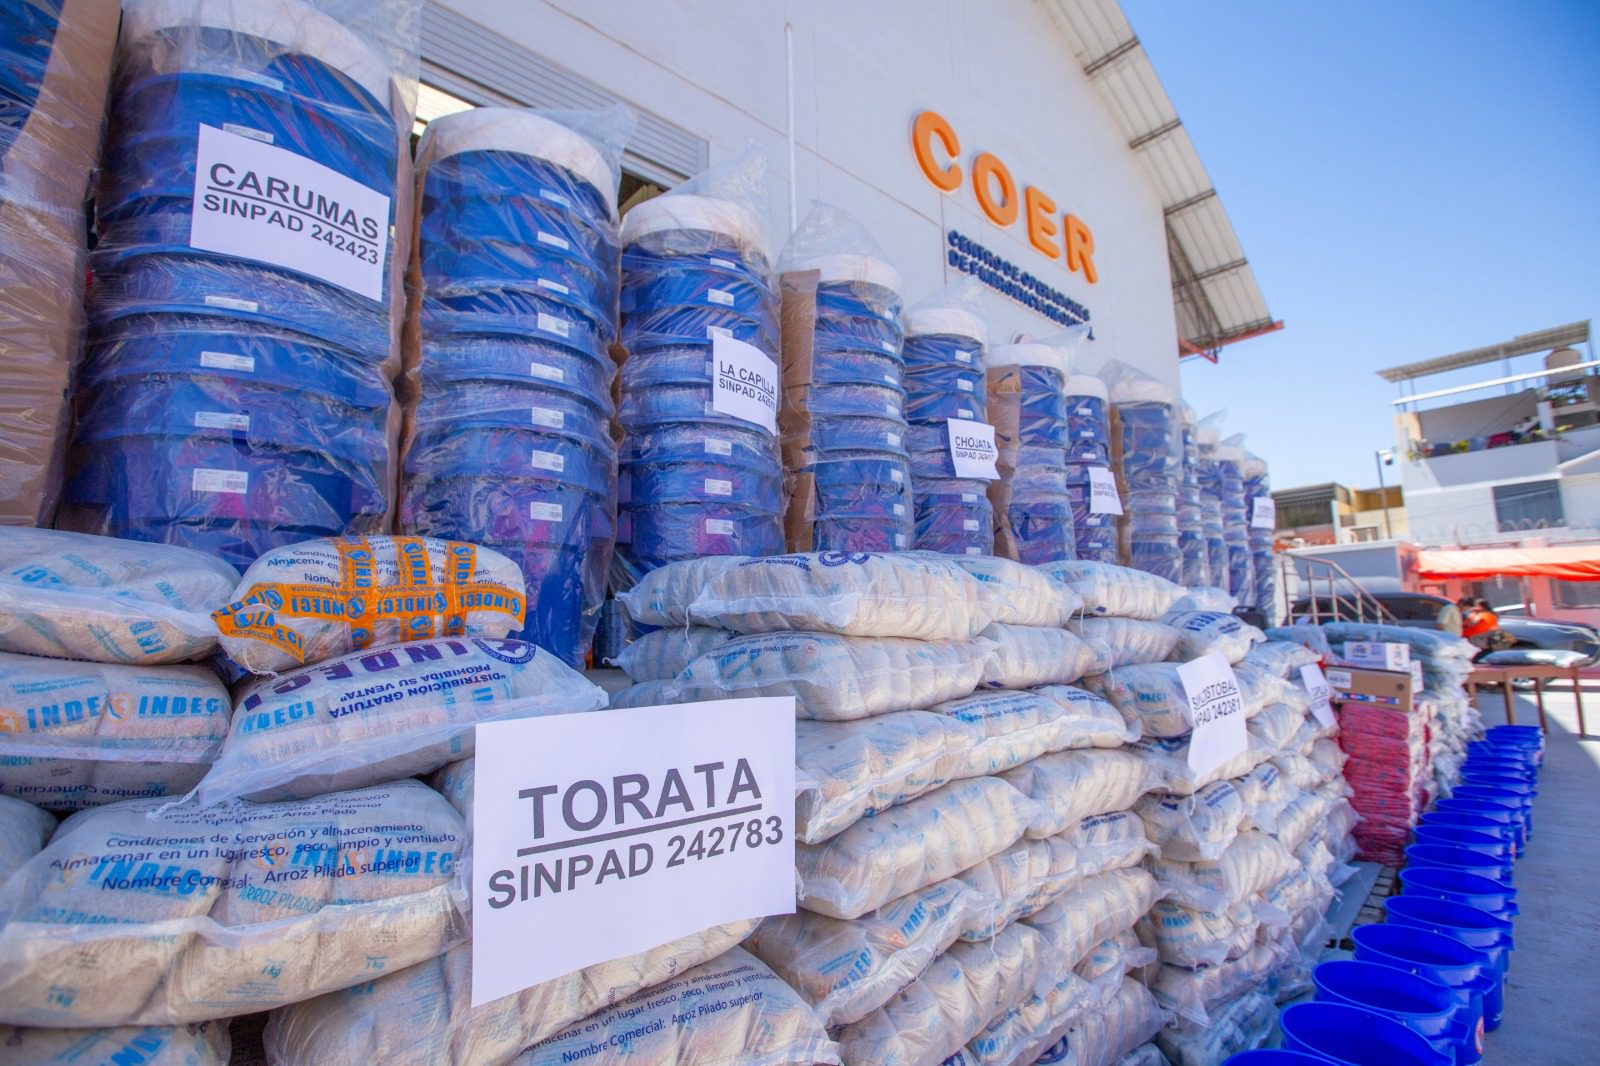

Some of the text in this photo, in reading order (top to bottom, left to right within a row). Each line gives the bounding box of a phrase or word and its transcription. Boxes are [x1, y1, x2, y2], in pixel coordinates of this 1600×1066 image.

[209, 162, 378, 240] CARUMAS
[912, 110, 1097, 285] COER
[203, 193, 378, 265] SINPAD 242423
[719, 377, 755, 399] SINPAD
[720, 360, 775, 396] LA CAPILLA
[955, 436, 993, 450] CHOJATA
[267, 557, 340, 571] Almacenar en
[377, 597, 432, 615] INDECI
[459, 593, 510, 608] INDECI
[243, 640, 469, 713] INDECI
[399, 677, 418, 689] SU
[421, 664, 492, 681] PROHIBIDA
[330, 691, 404, 719] GRATUITA
[102, 788, 162, 798] Nombre
[518, 757, 762, 840] TORATA
[106, 836, 205, 847] Condiciones
[210, 834, 229, 844] de
[311, 828, 318, 838] y
[50, 850, 153, 871] Almacenar
[159, 849, 181, 861] en
[187, 848, 209, 859] un
[295, 841, 331, 854] seco,
[337, 838, 380, 852] limpio
[385, 837, 392, 847] y
[373, 848, 455, 875] INDEC
[487, 815, 784, 910] SINPAD 242783
[102, 872, 182, 891] Nombre
[264, 867, 308, 884] Arroz
[314, 864, 356, 879] Pilado
[360, 855, 421, 874] superior
[585, 1024, 600, 1033] en
[602, 1015, 616, 1027] un
[617, 1006, 645, 1021] lugar
[646, 993, 680, 1010] fresco,
[682, 986, 705, 1000] seco,
[705, 979, 735, 993] limpio
[626, 980, 683, 1005] conservación
[562, 1041, 608, 1064] Nombre
[610, 1019, 667, 1048] Comercial:
[697, 999, 728, 1017] Pilado
